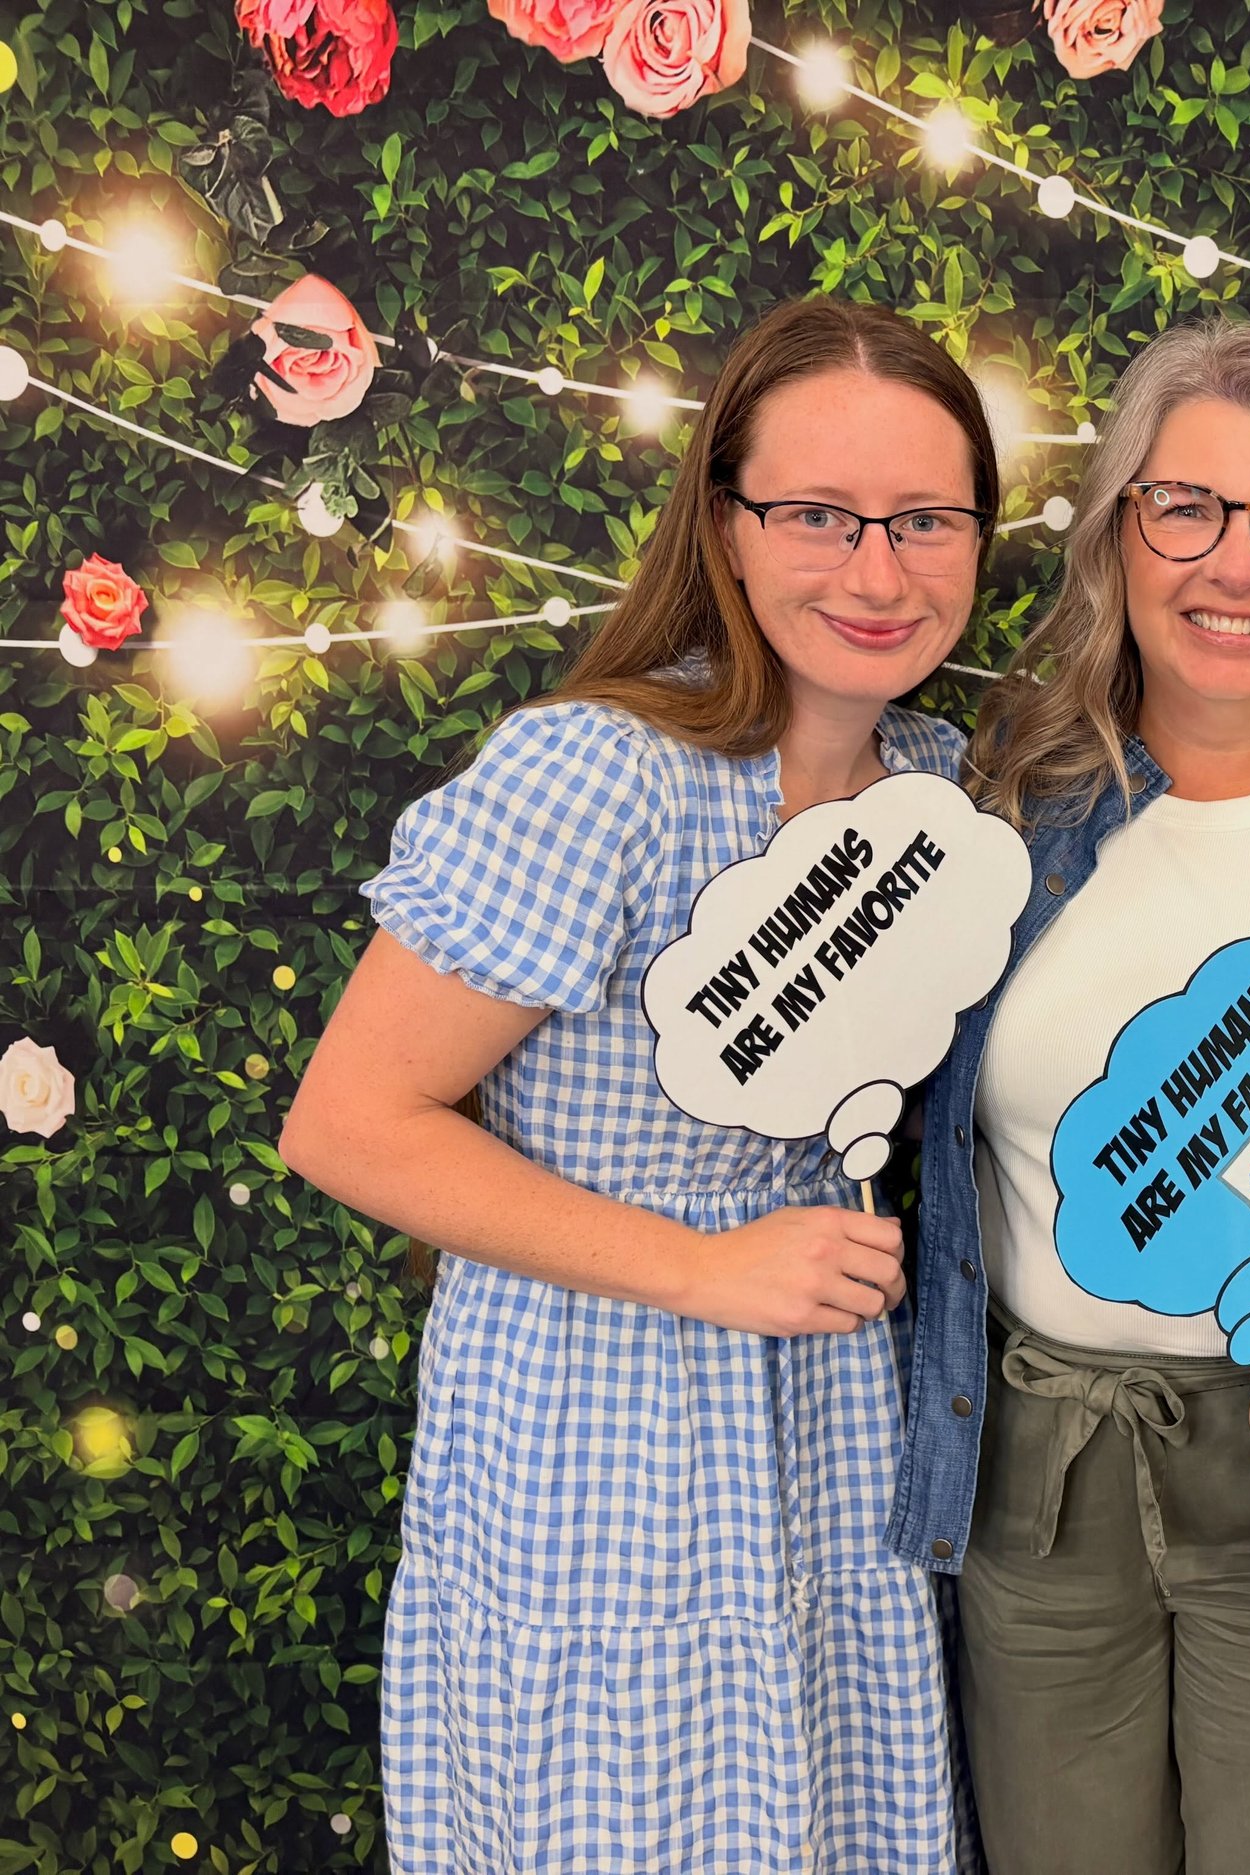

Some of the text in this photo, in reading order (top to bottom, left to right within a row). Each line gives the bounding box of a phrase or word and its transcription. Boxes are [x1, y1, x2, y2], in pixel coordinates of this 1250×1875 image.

[686, 828, 873, 1028] TINY HUMANS
[719, 829, 946, 1086] ARE MY FAVORITE
[1093, 1096, 1168, 1186] TINY
[1120, 1168, 1186, 1253] ARE
[1175, 1113, 1229, 1191] MY
